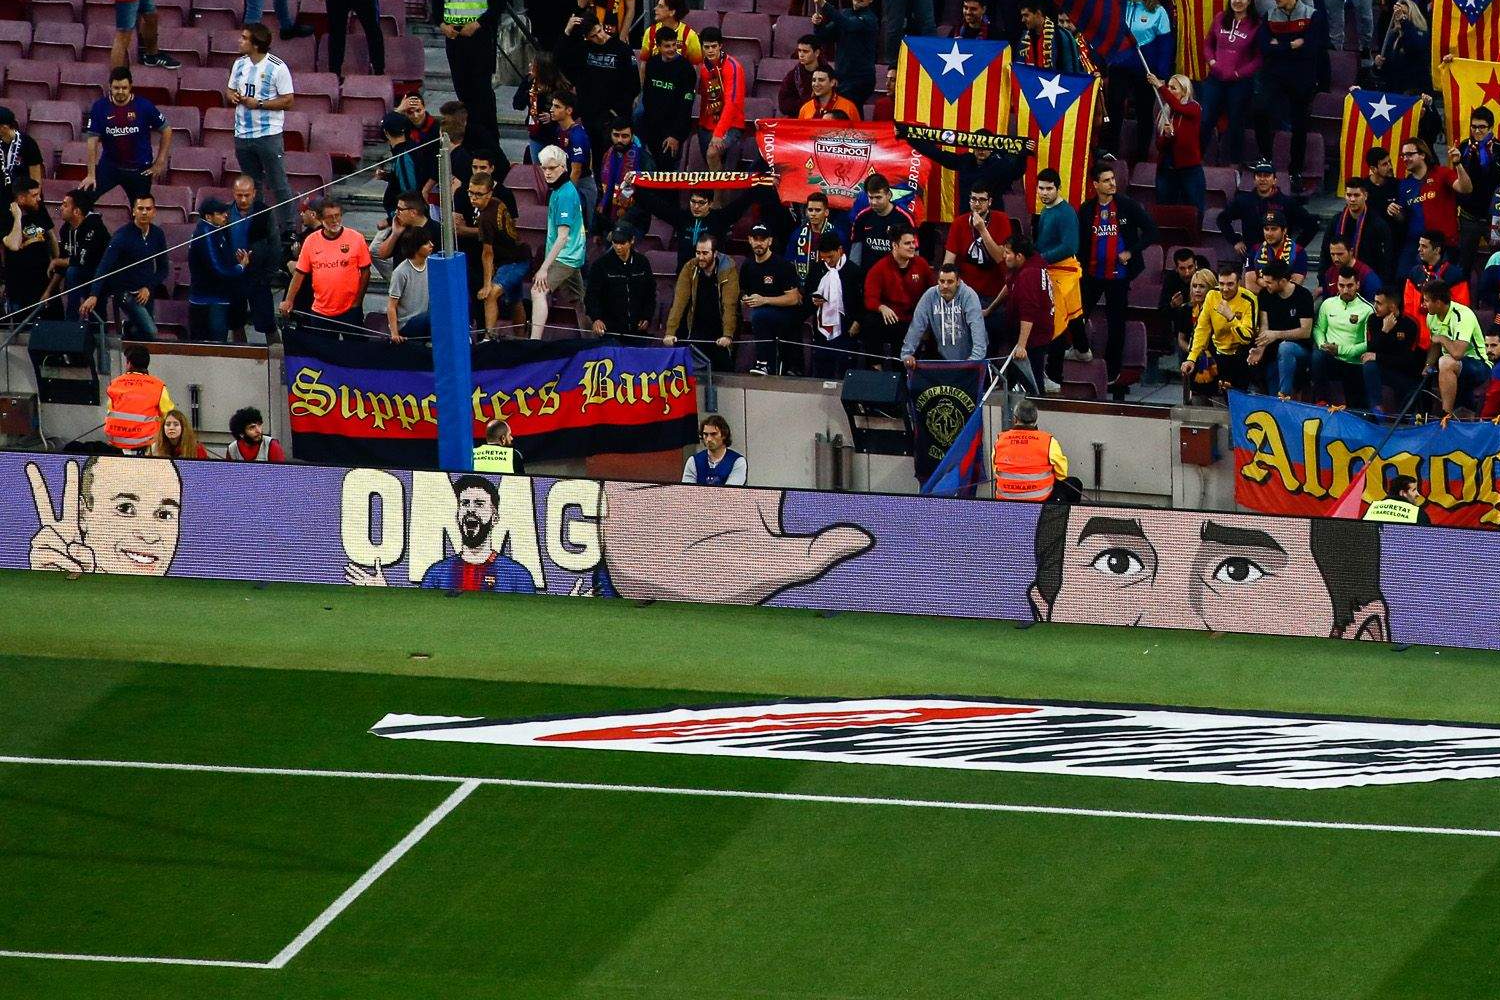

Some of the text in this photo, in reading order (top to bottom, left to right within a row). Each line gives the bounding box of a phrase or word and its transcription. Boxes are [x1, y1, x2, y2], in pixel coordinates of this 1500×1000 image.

[245, 83, 256, 98] 10
[652, 78, 674, 90] TOUR
[105, 125, 139, 136] Rakuten
[957, 132, 1023, 151] PERICOS
[816, 143, 867, 158] LIVERPOOL
[1091, 224, 1118, 234] QATAR
[866, 237, 891, 247] QATAR
[578, 358, 692, 415] Barça
[340, 468, 606, 590] OMG
